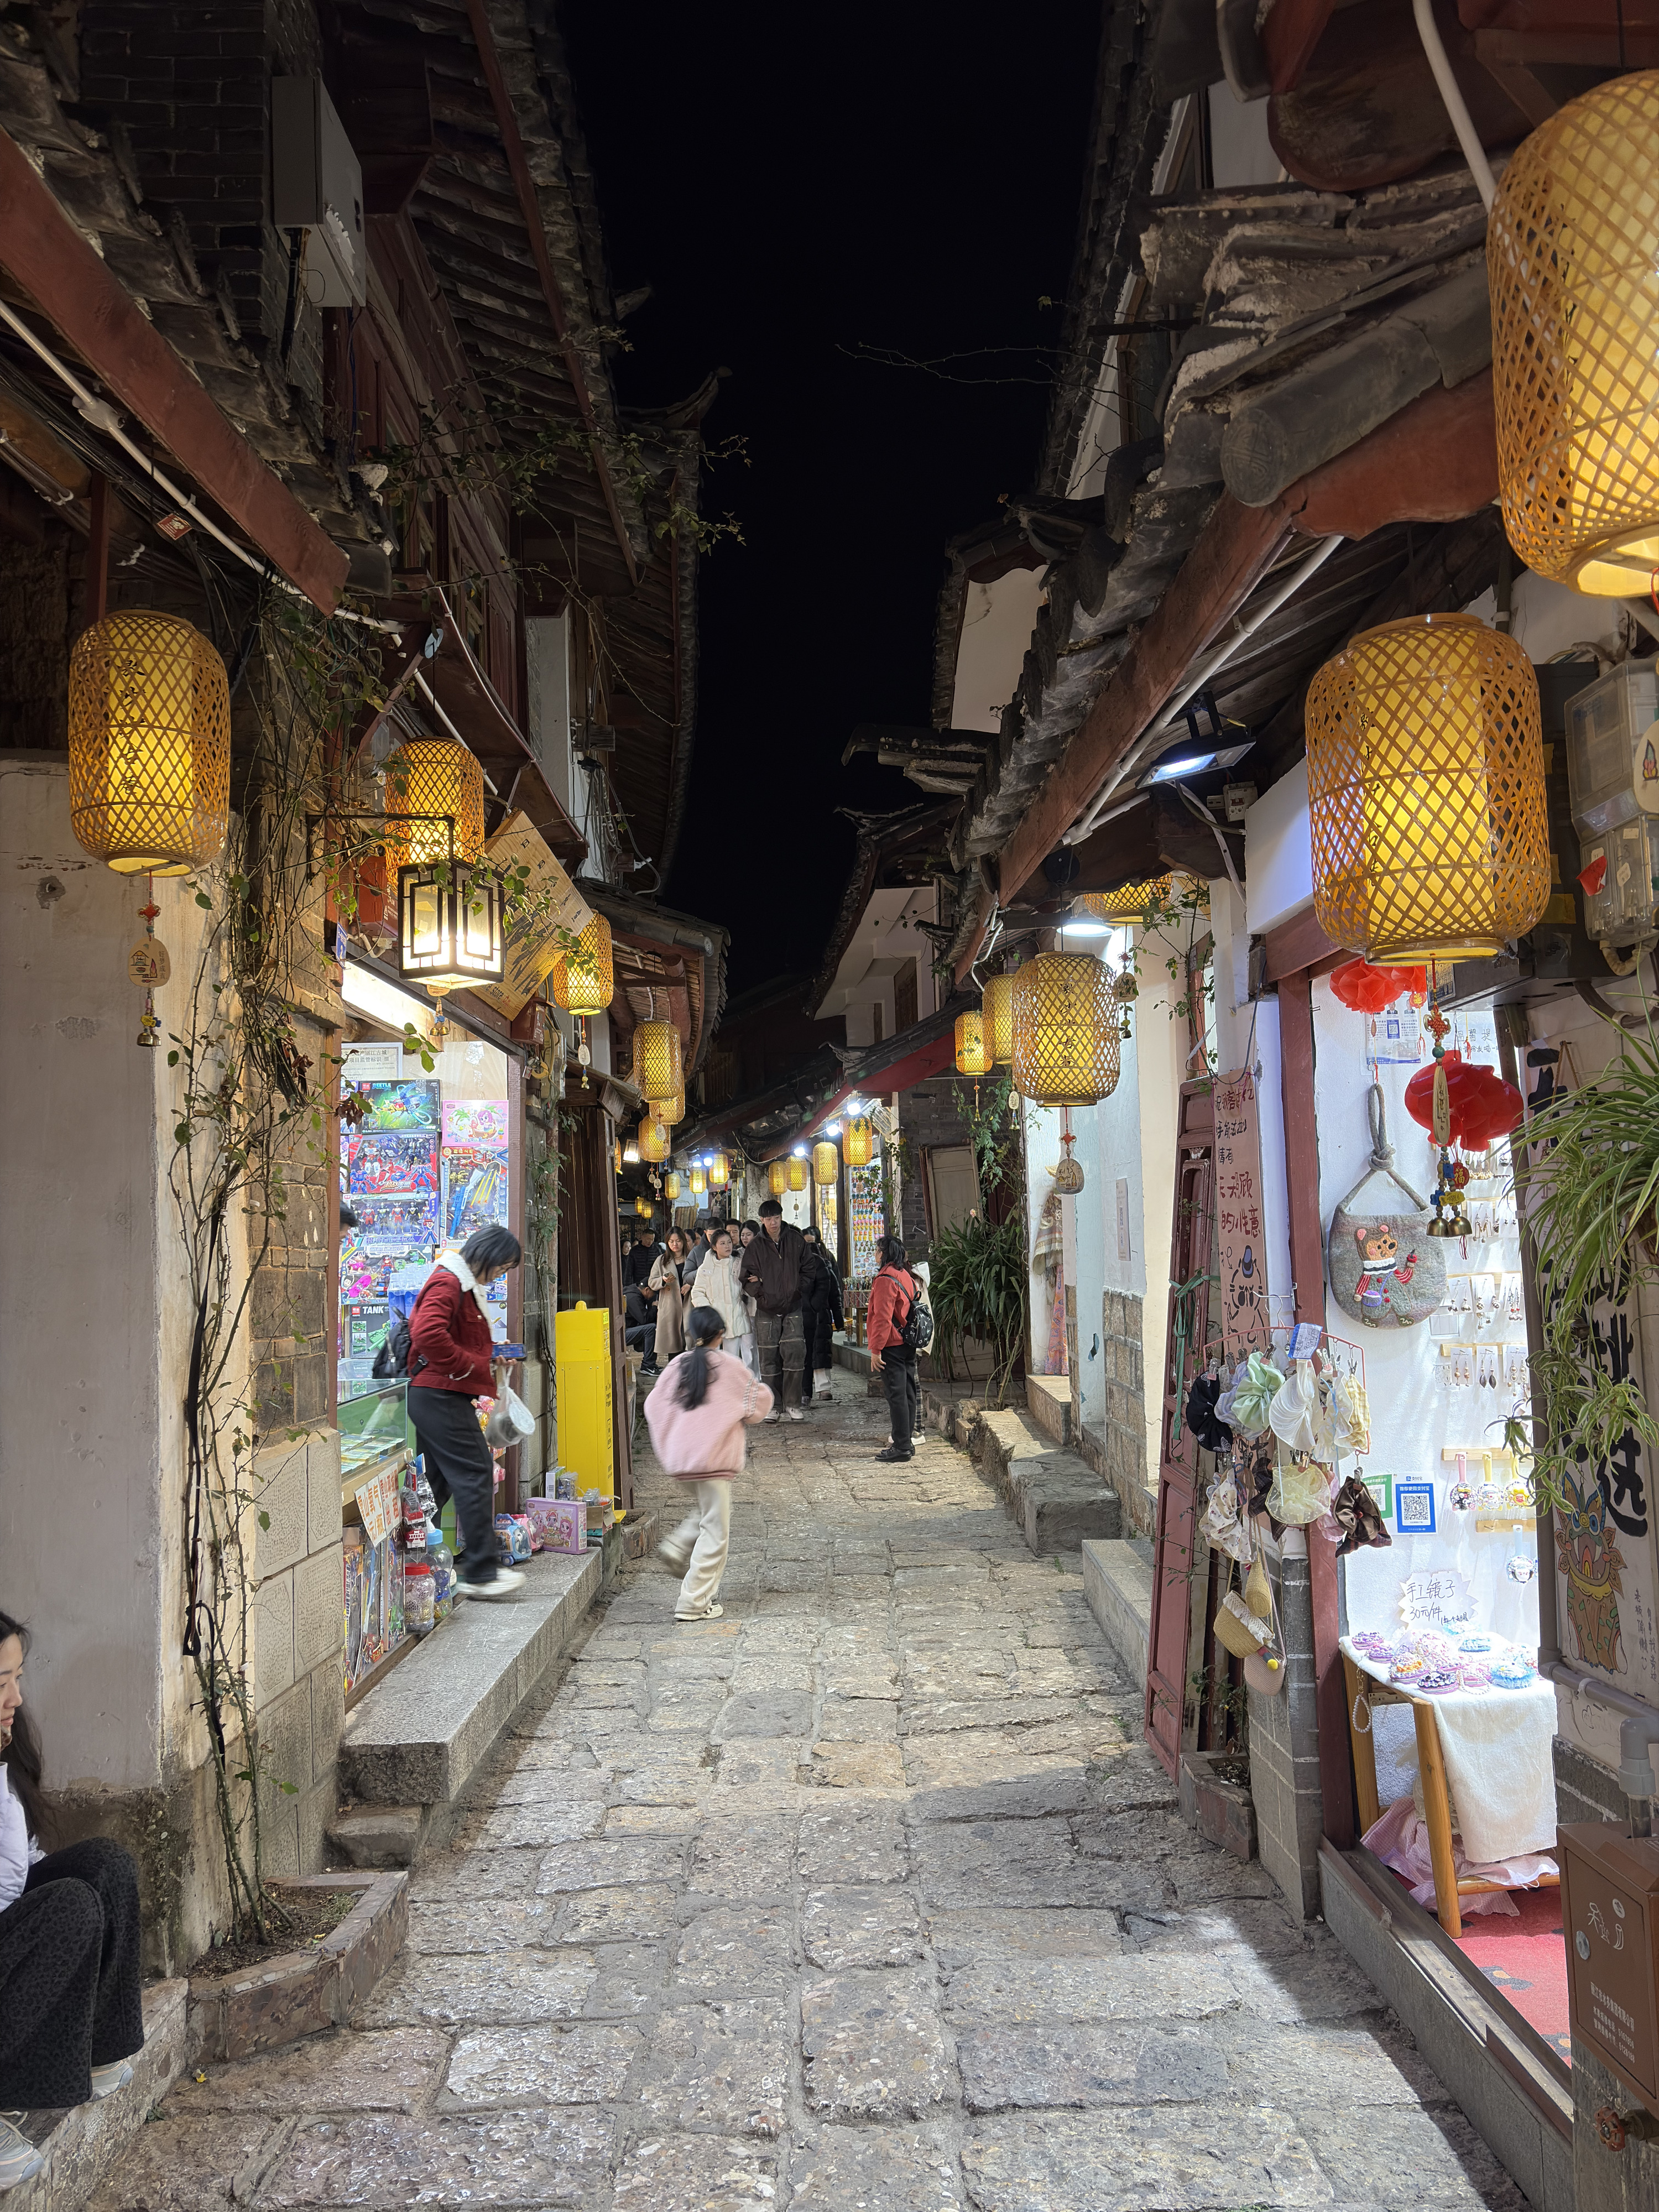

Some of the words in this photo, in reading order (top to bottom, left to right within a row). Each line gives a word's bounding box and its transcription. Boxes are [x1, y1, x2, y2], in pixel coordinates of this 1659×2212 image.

[490, 986, 504, 1000] store
[1454, 1168, 1465, 1185] 福
[357, 1484, 382, 1521] 雪山氧气
[1406, 1578, 1455, 1603] 手工镜子
[1410, 1602, 1443, 1622] 30元/件
